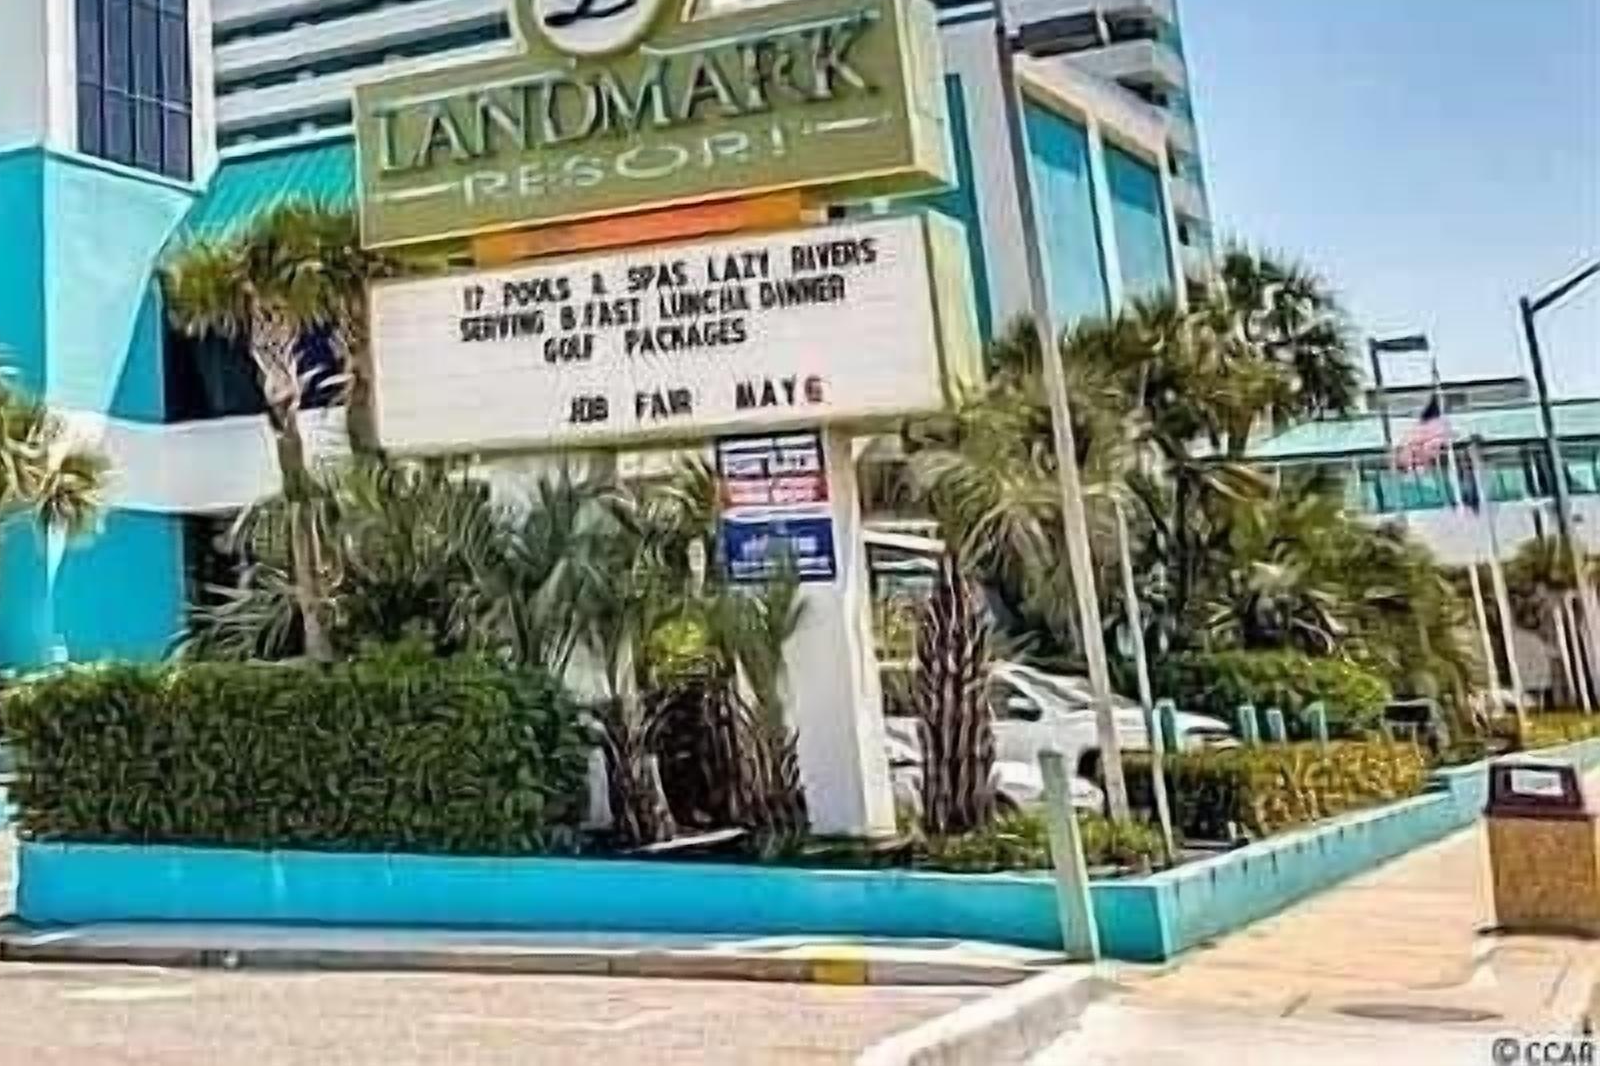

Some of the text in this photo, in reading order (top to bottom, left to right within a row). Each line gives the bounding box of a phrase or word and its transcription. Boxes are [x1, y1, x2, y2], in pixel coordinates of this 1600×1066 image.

[373, 20, 880, 173] LANDMARK
[503, 277, 571, 307] POOLS
[626, 261, 688, 292] SPAS
[707, 251, 770, 283] LAZY
[790, 238, 878, 273] RIVERS
[460, 310, 545, 342] SERVING
[759, 274, 845, 308] DINNER
[543, 317, 747, 363] GOLF PACKAGES
[569, 395, 608, 423] JOB
[635, 386, 693, 418] FAIR
[735, 374, 796, 409] MAY
